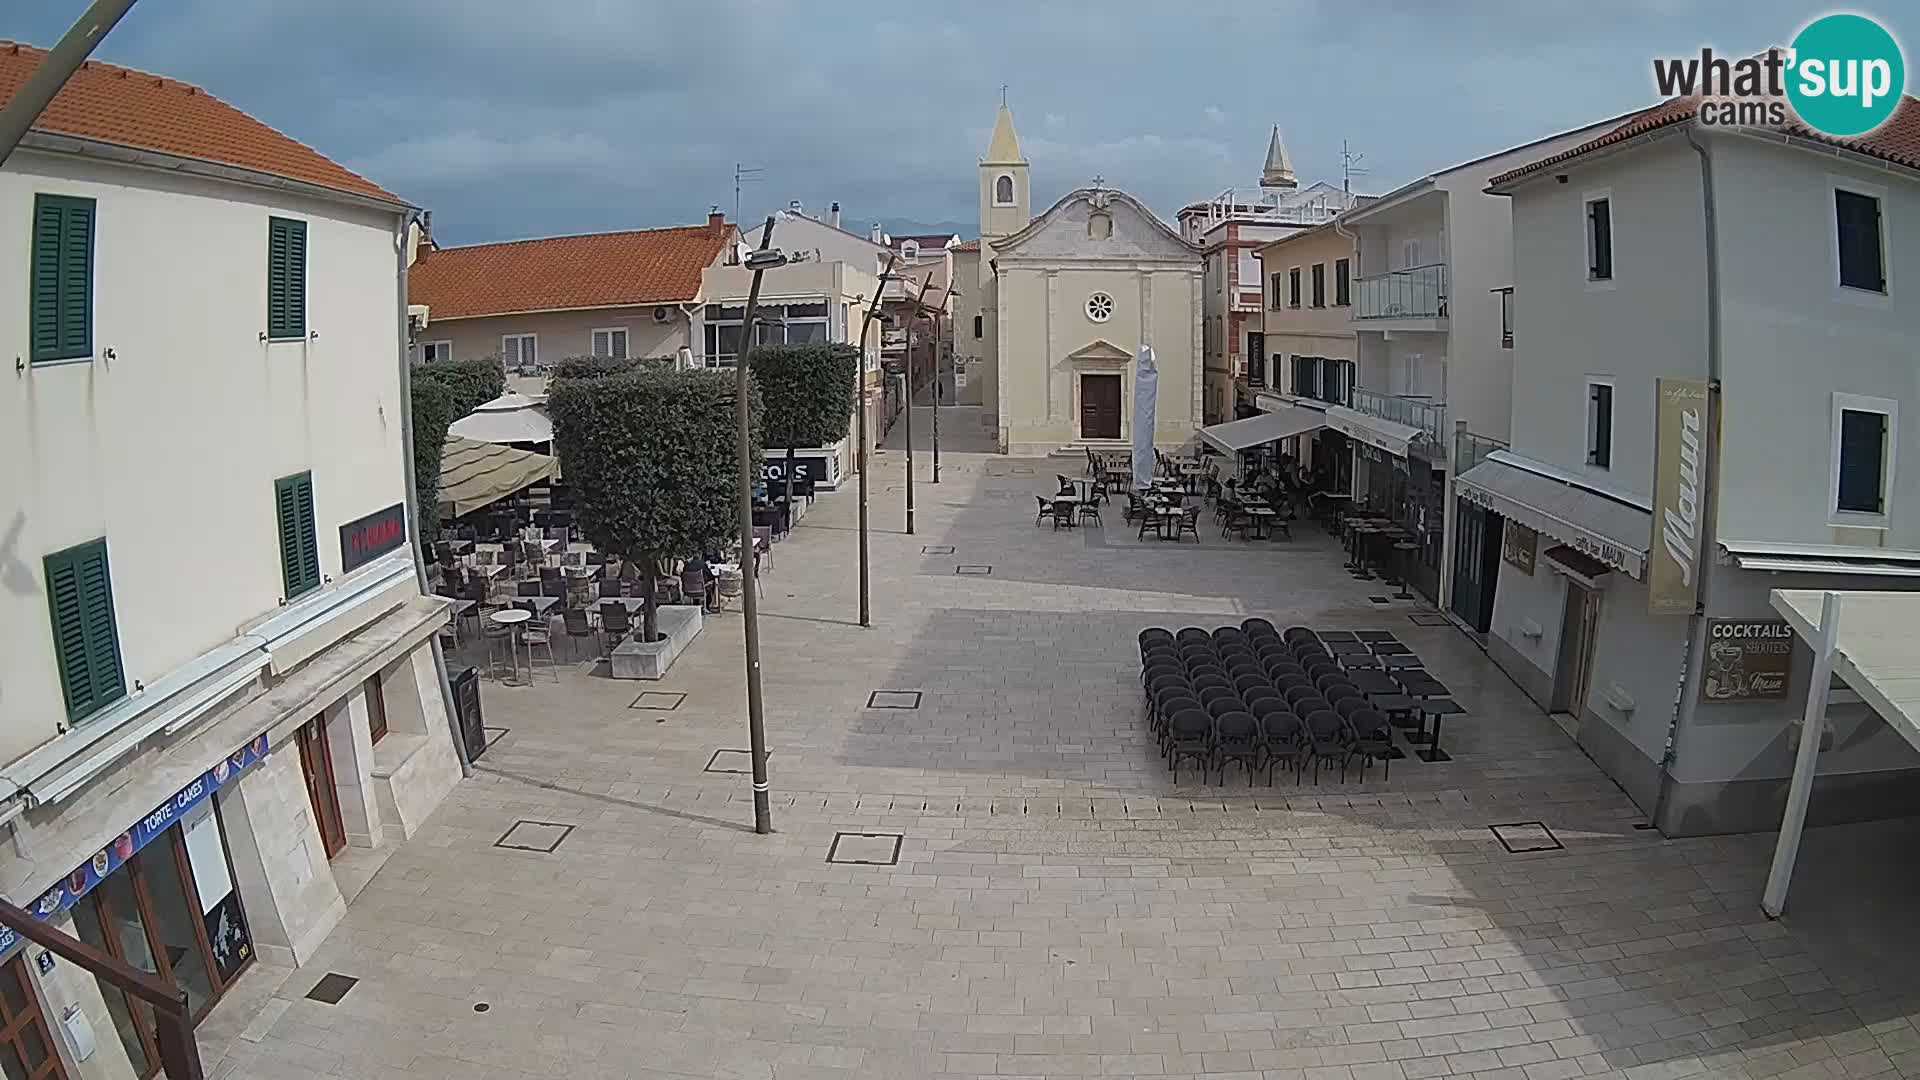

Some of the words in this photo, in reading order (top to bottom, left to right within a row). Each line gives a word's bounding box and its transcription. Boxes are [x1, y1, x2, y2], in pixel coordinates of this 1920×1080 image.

[1663, 407, 1700, 587] Maun
[1712, 624, 1792, 638] COCKTAILS
[143, 802, 174, 833] TORTE
[177, 779, 204, 808] CAKES
